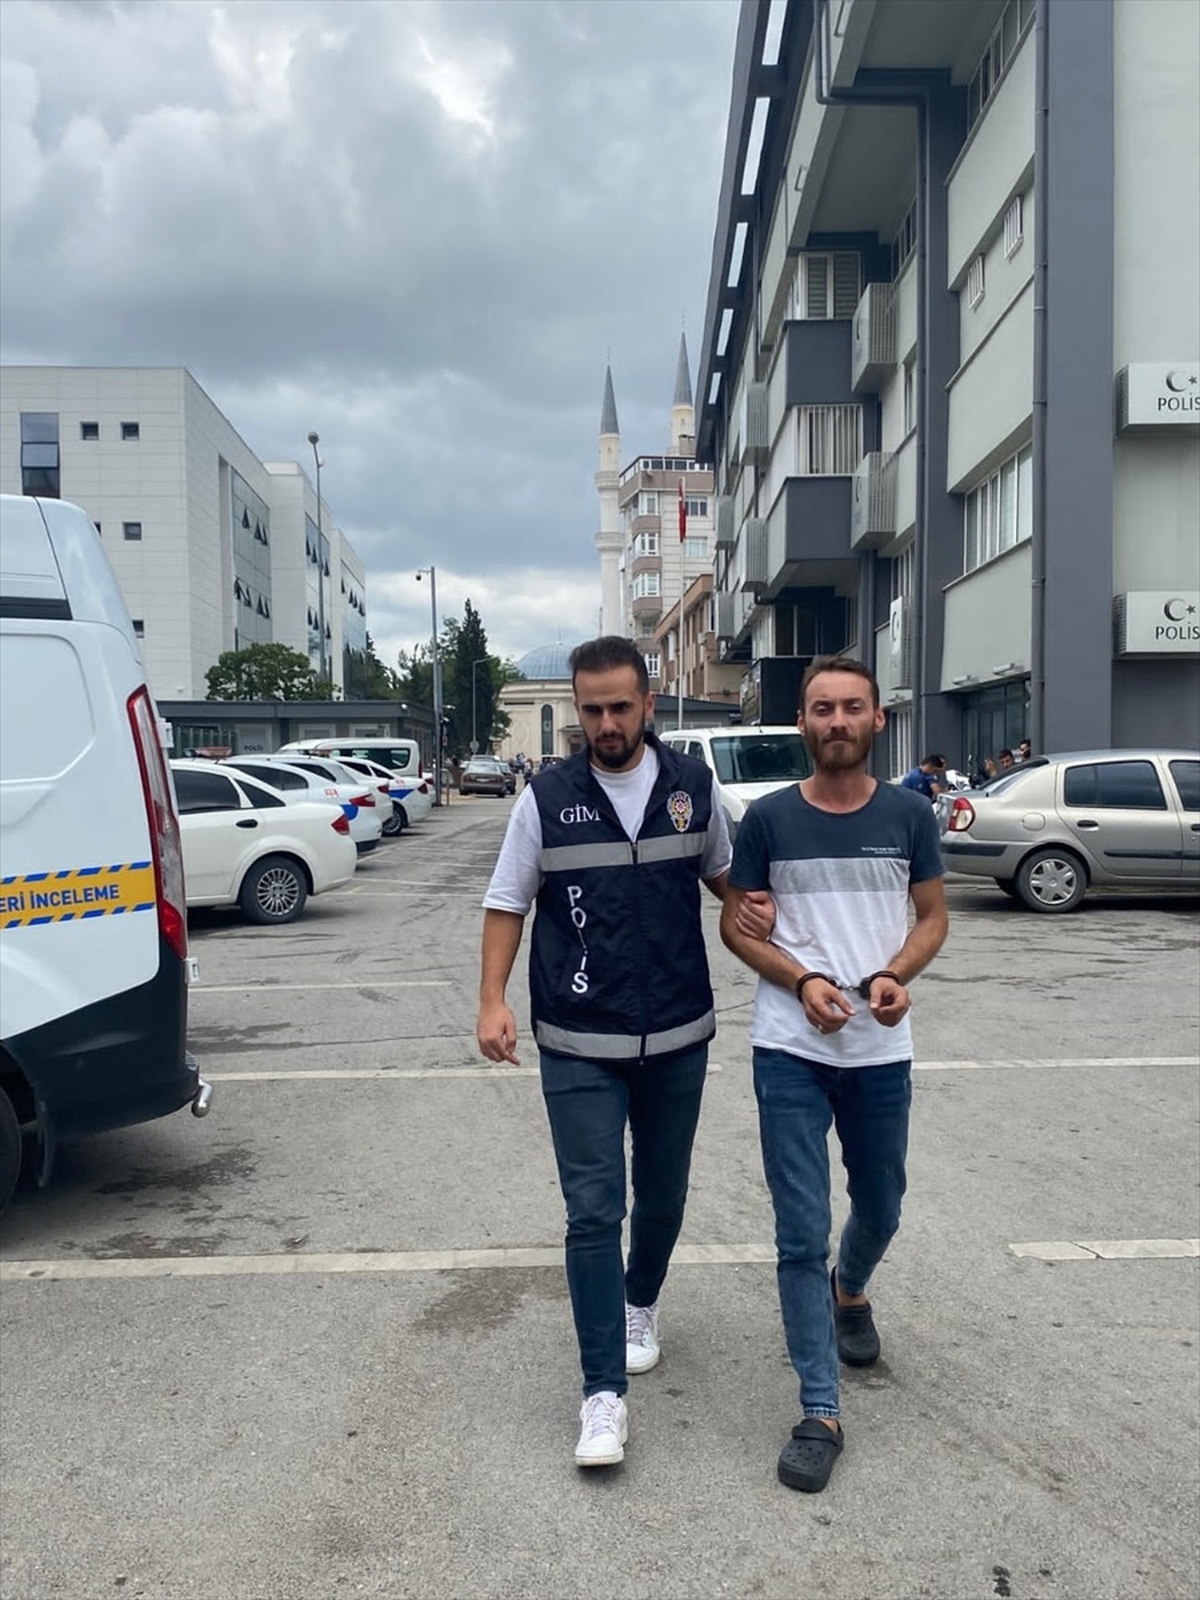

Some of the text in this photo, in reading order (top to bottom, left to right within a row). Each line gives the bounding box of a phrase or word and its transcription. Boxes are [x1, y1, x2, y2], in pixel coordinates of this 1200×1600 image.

[1156, 621, 1200, 640] POLİS
[560, 804, 601, 823] GİM
[30, 885, 119, 909] İNCELEME
